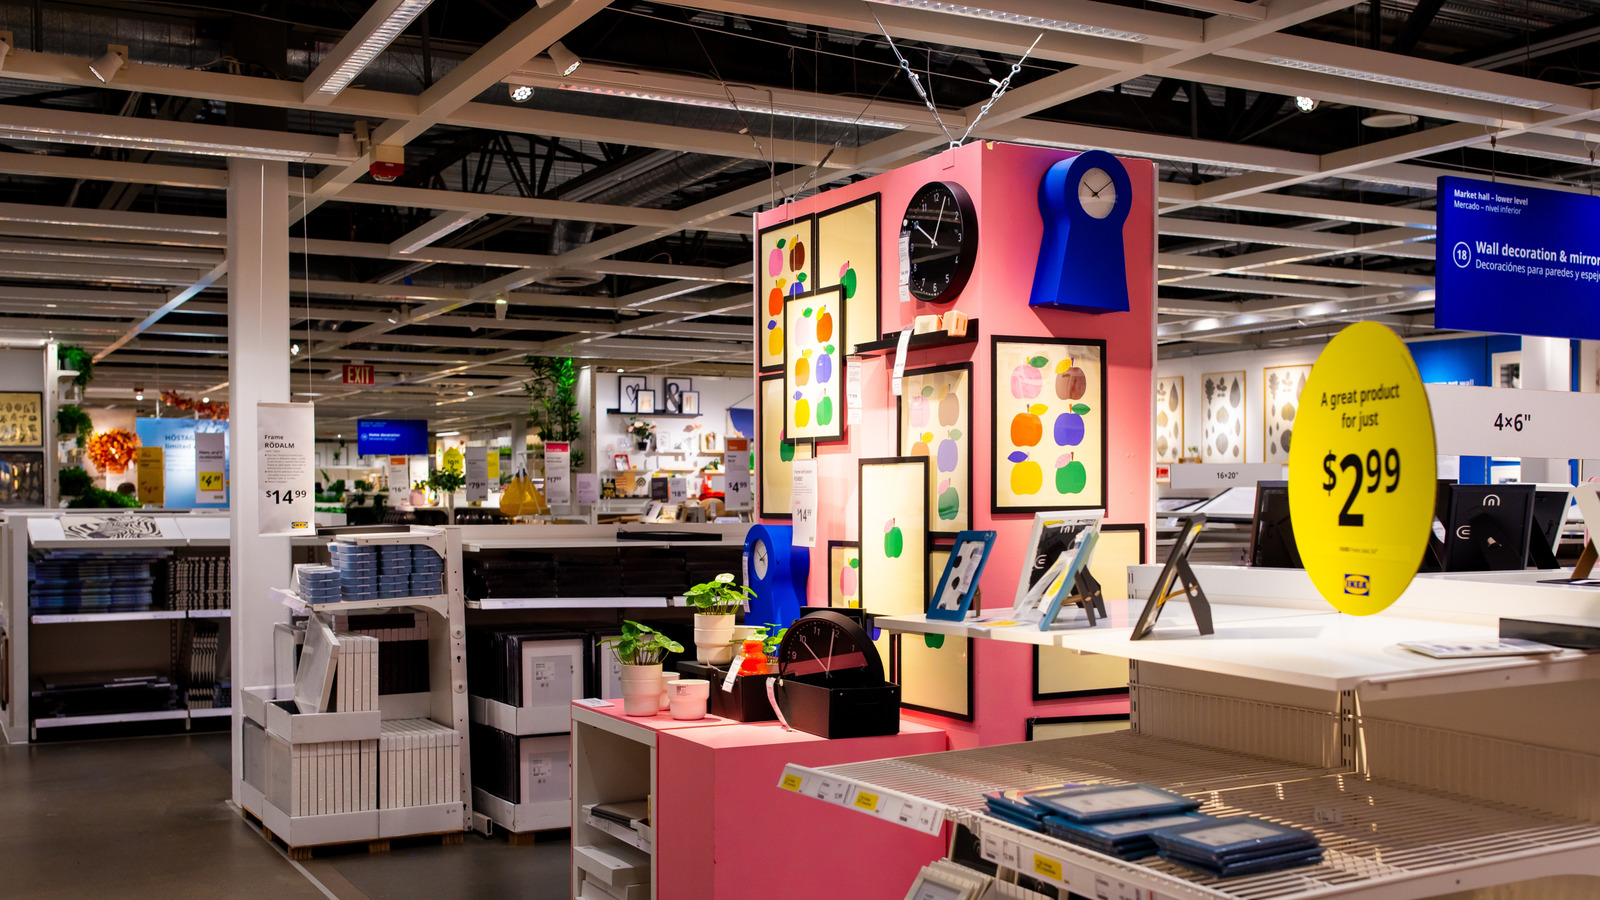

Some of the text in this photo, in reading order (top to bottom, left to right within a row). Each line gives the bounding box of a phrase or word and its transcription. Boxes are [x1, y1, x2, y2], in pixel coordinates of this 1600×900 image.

[933, 192, 940, 202] 12
[1454, 189, 1477, 200] Market
[1478, 191, 1490, 201] hall
[1495, 194, 1513, 204] lower
[1514, 196, 1528, 206] level
[921, 203, 928, 212] 11
[1454, 200, 1480, 211] Mercado
[1485, 203, 1499, 213] nivel
[1500, 205, 1521, 215] inferior
[954, 211, 959, 220] 2
[957, 233, 962, 242] 3
[1456, 249, 1468, 261] 18
[1475, 241, 1499, 256] Wall
[1501, 243, 1557, 262] decoration
[1559, 250, 1567, 263] &
[1475, 258, 1600, 283] Decoraciónes para paredes y espej
[921, 278, 926, 287] 7
[945, 274, 950, 283] 5
[347, 366, 370, 384] EXIT
[1320, 383, 1400, 410] A great product
[1341, 411, 1379, 432] for just
[264, 441, 295, 449] RÖDALM
[813, 626, 821, 636] 11
[791, 651, 797, 660] 9
